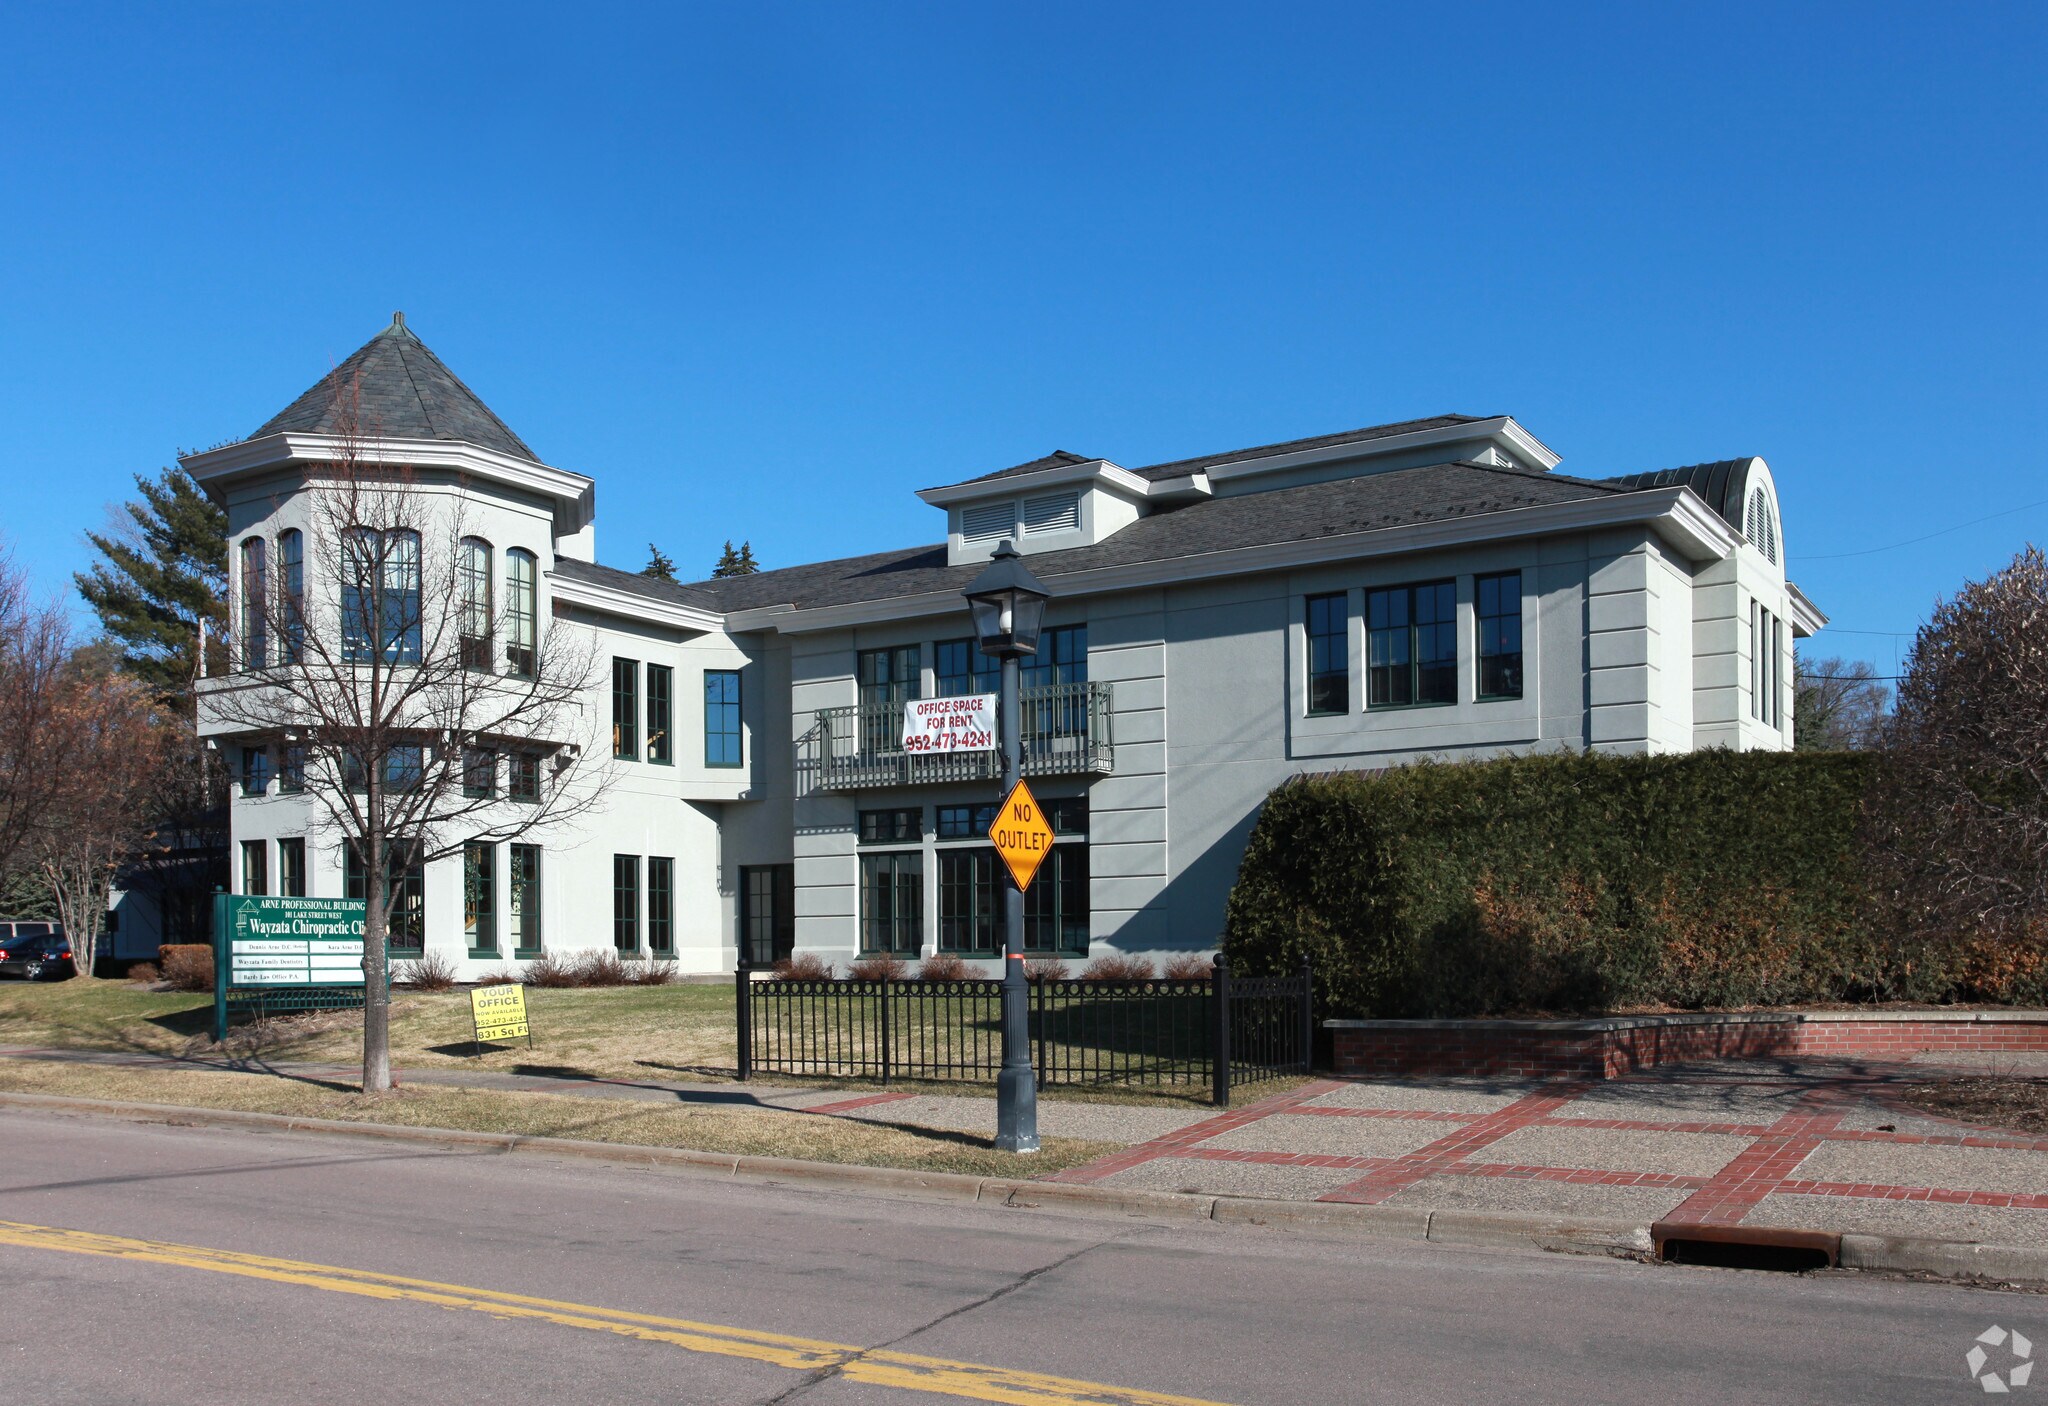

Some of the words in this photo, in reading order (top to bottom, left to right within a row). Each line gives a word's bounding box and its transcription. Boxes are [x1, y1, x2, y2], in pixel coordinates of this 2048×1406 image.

[917, 701, 950, 716] OFFICE
[953, 699, 983, 712] SPACE
[927, 717, 945, 729] FOR
[949, 715, 973, 728] RENT
[905, 730, 992, 751] 952-473-4241
[1014, 803, 1031, 822] NO
[998, 829, 1046, 850] OUTLET
[260, 899, 280, 909] ARNE
[281, 899, 332, 910] PROFESSIONAL
[333, 901, 366, 911] BUILDING
[293, 911, 307, 919] LAKE
[308, 911, 327, 919] STREET
[250, 918, 290, 938] Wayzata
[292, 919, 349, 938] Chiropractic
[481, 987, 514, 997] YOUR
[478, 997, 519, 1008] OFFICE
[476, 1016, 526, 1026] 952-473-4241
[478, 1030, 496, 1040] 831
[500, 1028, 514, 1037] Sq
[517, 1025, 528, 1033] Ft
